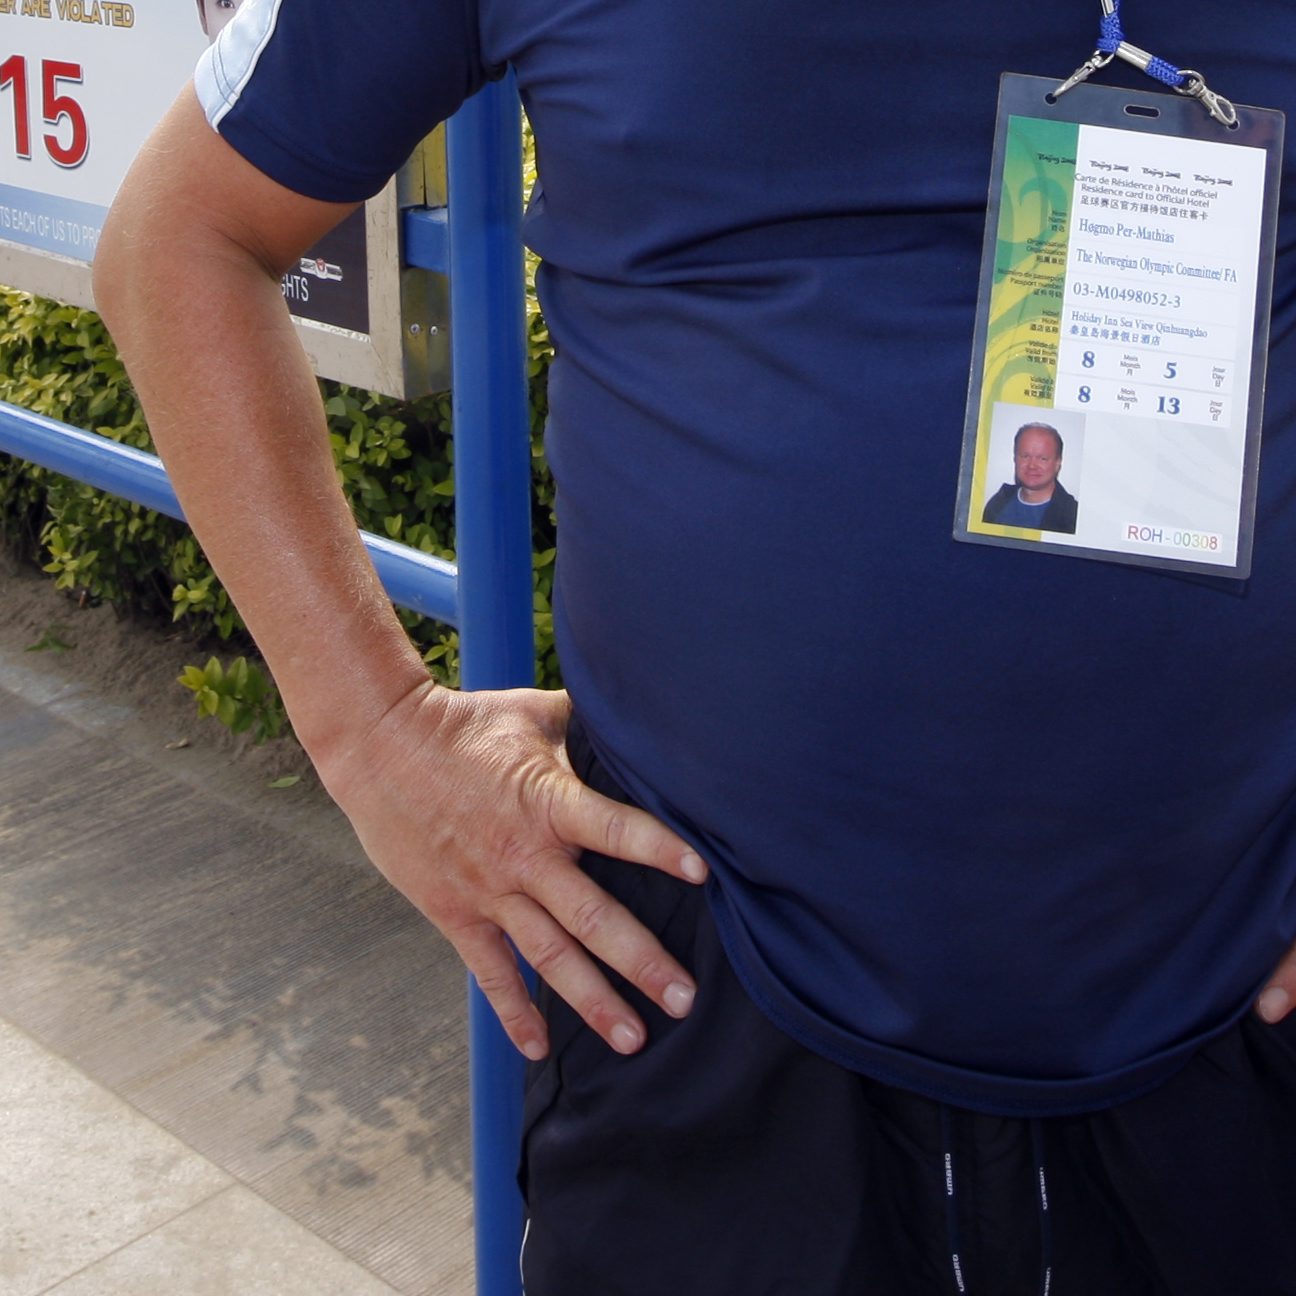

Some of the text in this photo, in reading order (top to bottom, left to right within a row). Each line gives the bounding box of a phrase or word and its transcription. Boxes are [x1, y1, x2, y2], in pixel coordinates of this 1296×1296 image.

[1074, 172, 1097, 184] Carte
[1098, 176, 1110, 185] de
[1081, 183, 1210, 208] Residence card to Official Hotel
[12, 209, 37, 235] EACH
[38, 215, 51, 237] OF
[53, 219, 66, 242] US
[66, 222, 82, 246] TO
[82, 224, 101, 249] PRO
[1115, 222, 1175, 244] Per-Mathias
[1076, 248, 1092, 263] The
[1094, 251, 1138, 271] Norwegian
[1139, 256, 1175, 276] Olympic
[1224, 268, 1237, 283] FA
[1073, 282, 1181, 308] 03-M0498052-3
[1071, 311, 1208, 339] Holiday Inn Sea View Qinhuangdao
[1081, 350, 1096, 369] 8
[1163, 362, 1177, 379] 5
[1078, 385, 1092, 403] 8
[1156, 396, 1181, 415] 13
